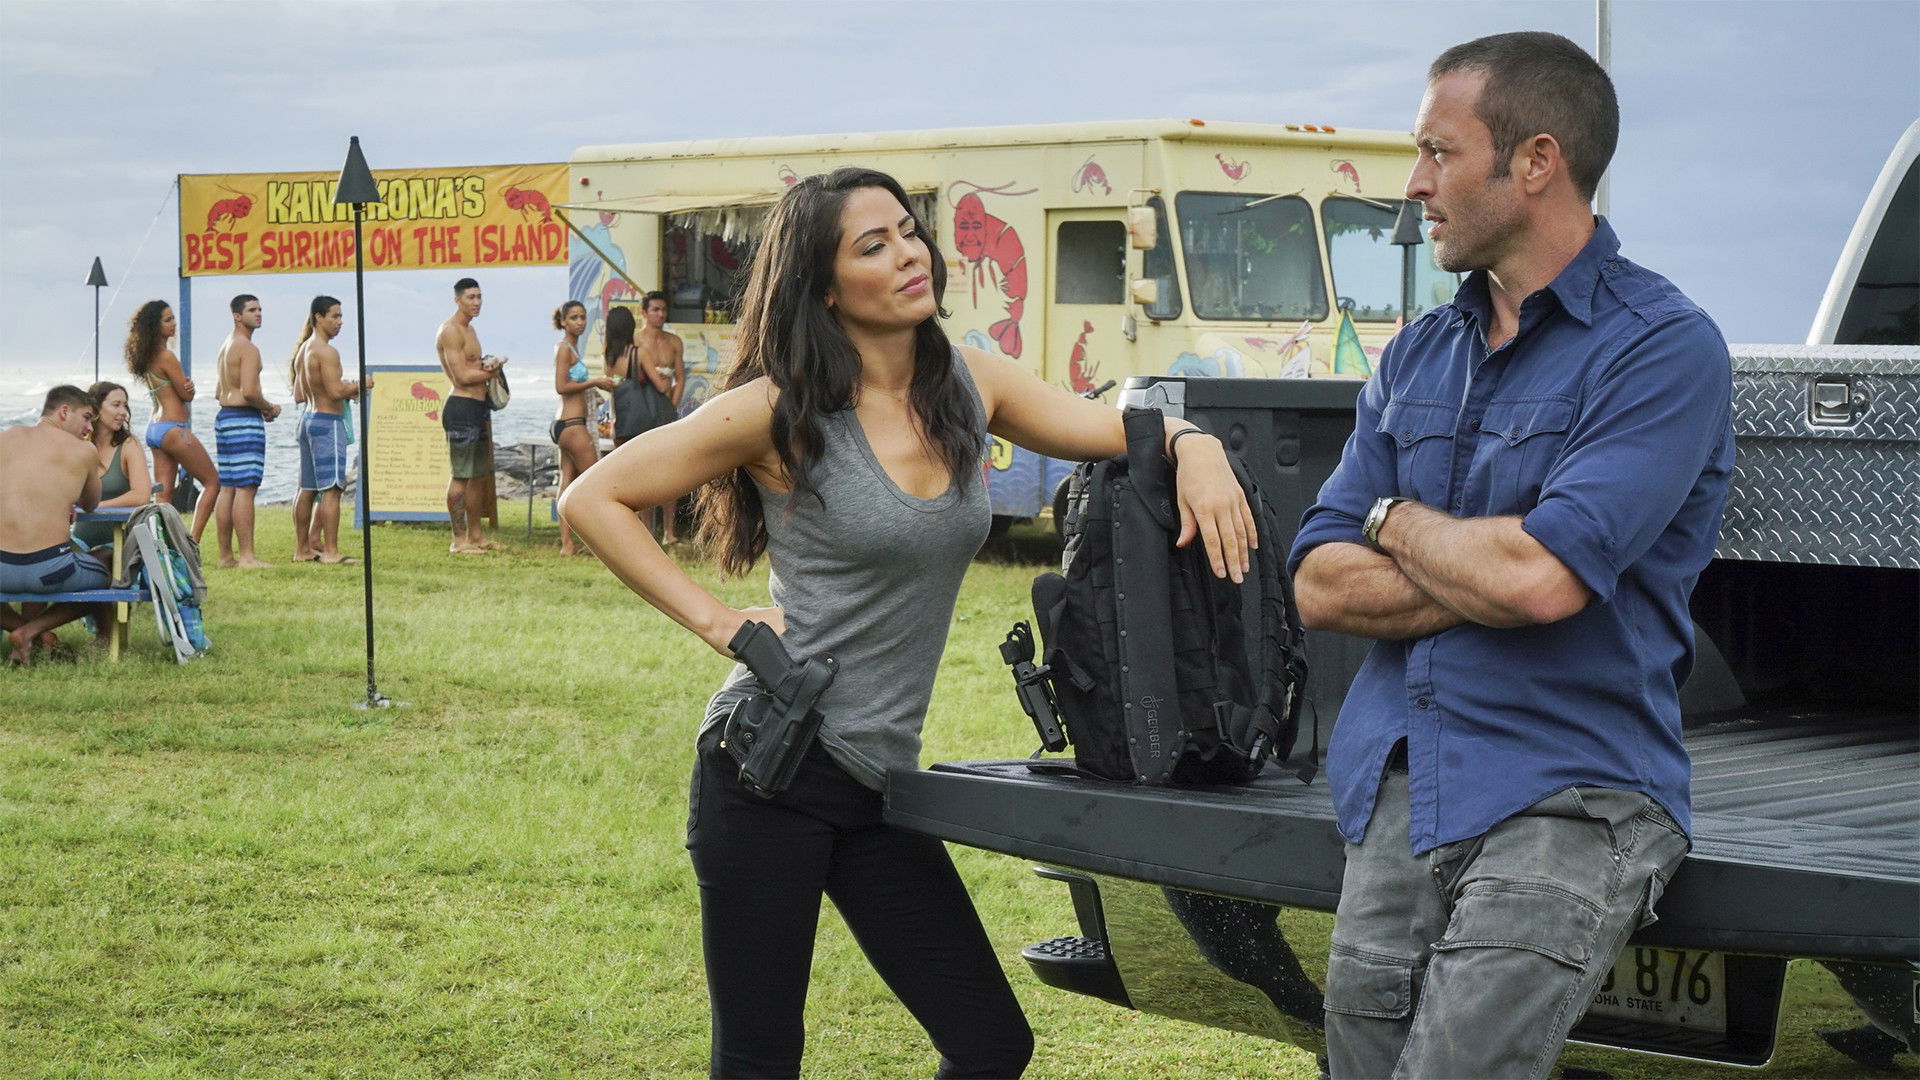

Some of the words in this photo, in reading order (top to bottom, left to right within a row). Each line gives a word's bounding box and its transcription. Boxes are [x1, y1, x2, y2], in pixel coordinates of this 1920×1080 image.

[186, 232, 248, 271] BEST
[260, 228, 356, 268] SHRIMP
[370, 228, 403, 266] ON
[413, 226, 462, 265] THE
[474, 223, 569, 264] ISLAND!
[1147, 709, 1161, 758] GERBER
[1635, 947, 1711, 1006] 876
[1592, 993, 1620, 1007] OHA
[1626, 996, 1663, 1013] STATE
